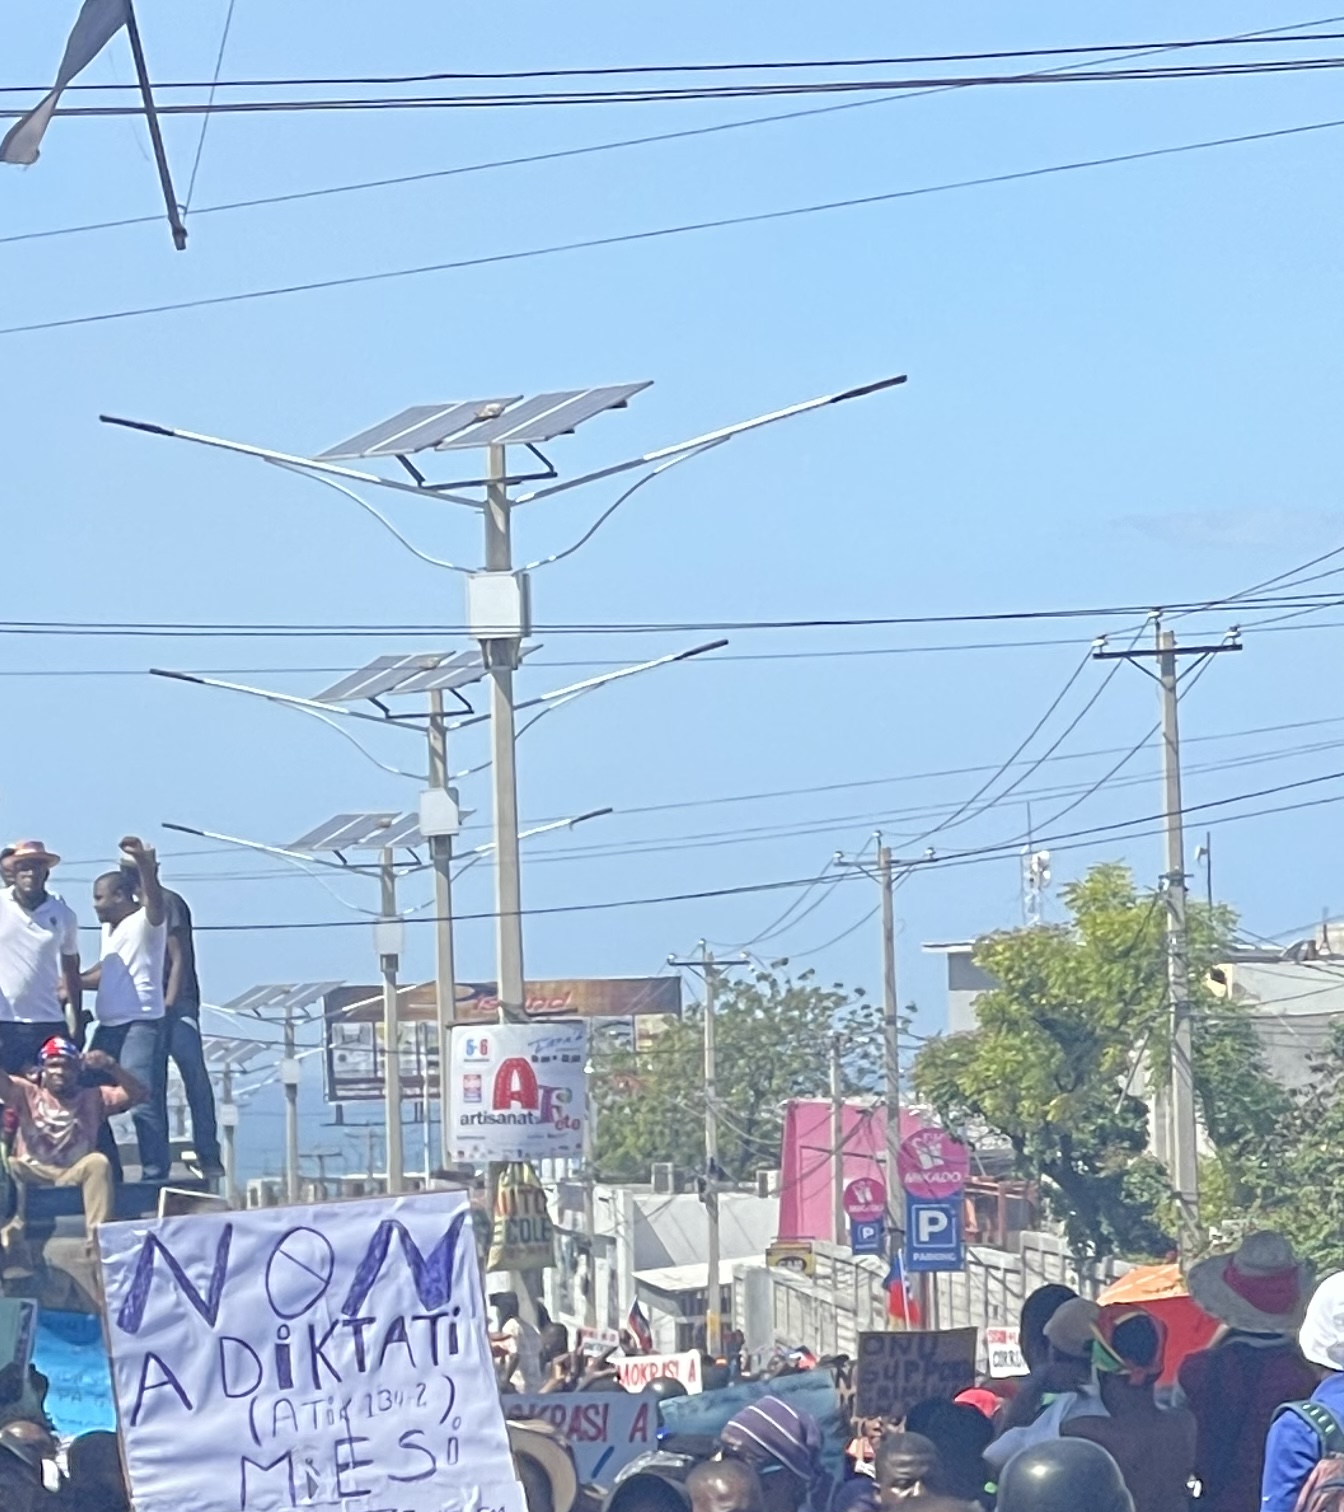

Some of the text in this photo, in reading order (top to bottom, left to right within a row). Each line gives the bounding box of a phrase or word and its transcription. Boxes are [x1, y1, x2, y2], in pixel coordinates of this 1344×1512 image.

[460, 1109, 534, 1126] artisanat
[904, 1171, 962, 1183] MIKADO
[918, 1209, 949, 1242] P
[116, 1210, 466, 1335] NON
[912, 1252, 957, 1262] PARKING
[129, 1352, 194, 1428] A
[628, 1402, 650, 1443] A
